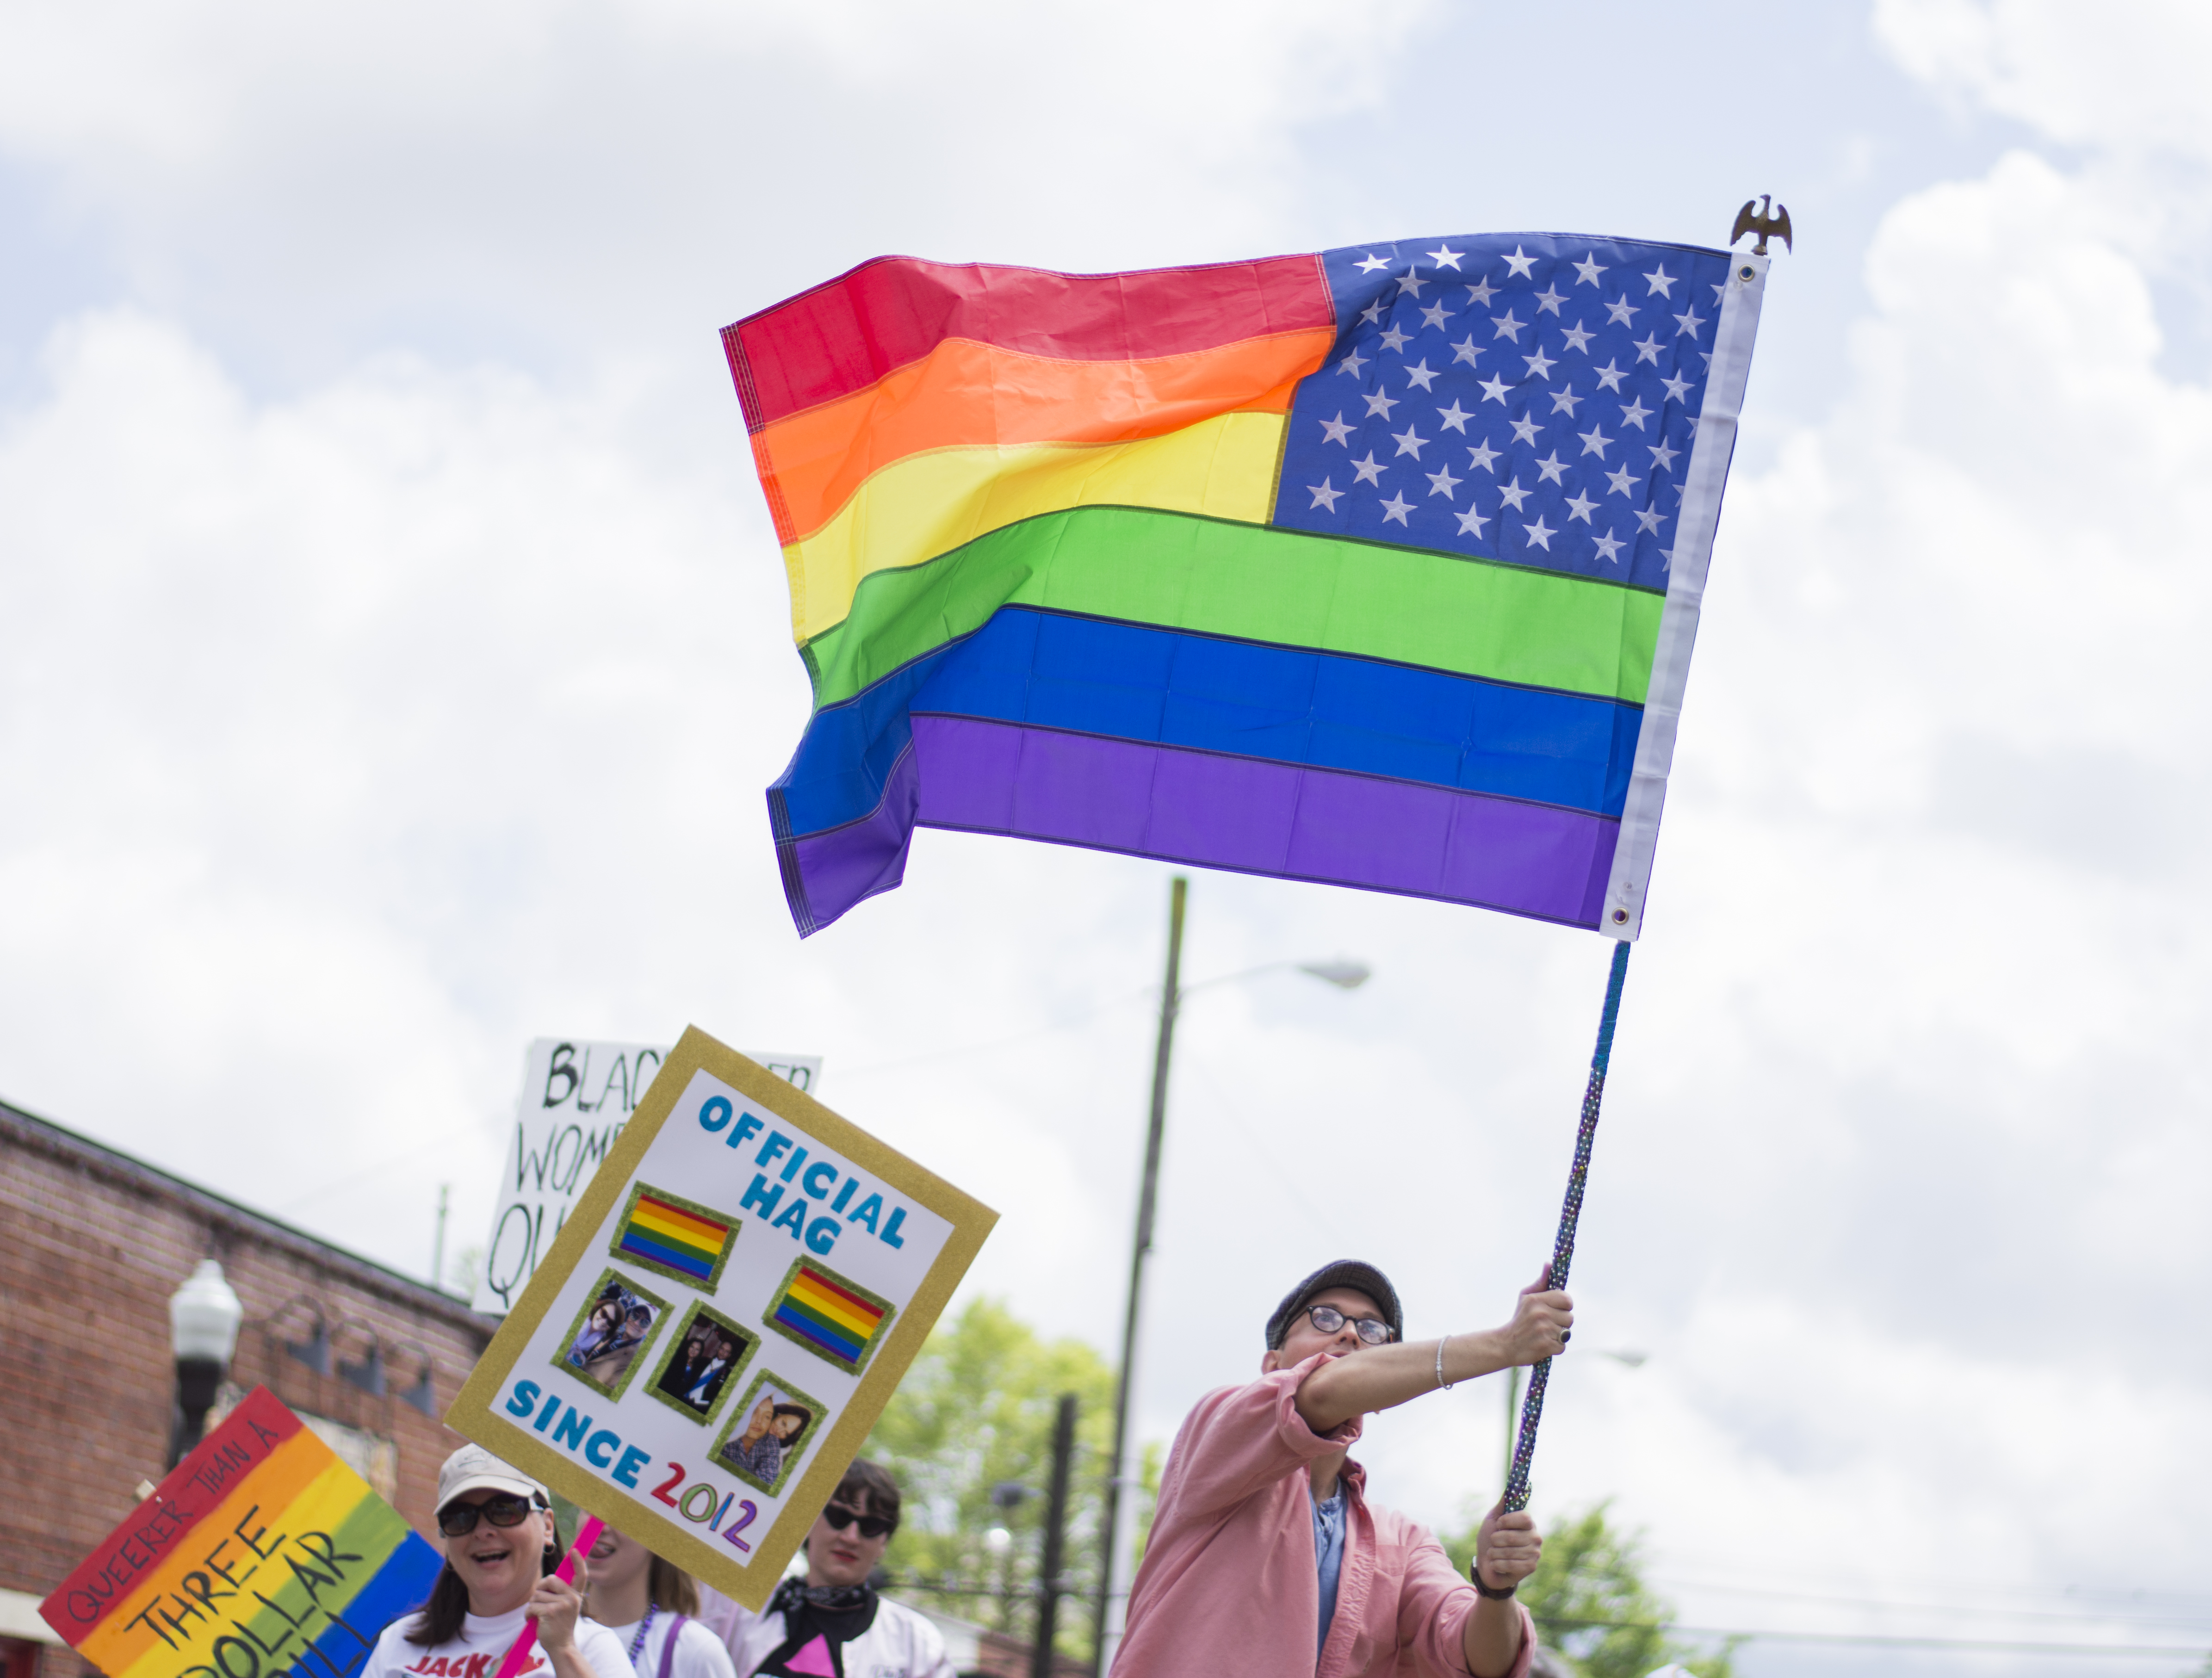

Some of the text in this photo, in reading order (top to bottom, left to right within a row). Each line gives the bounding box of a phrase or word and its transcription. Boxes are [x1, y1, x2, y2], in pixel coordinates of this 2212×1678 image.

[542, 1042, 671, 1112] BLAC
[698, 1095, 907, 1250] OFFICIAL
[739, 1173, 842, 1256] HAG
[68, 1420, 279, 1623] QUEERER THAN A
[505, 1379, 757, 1553] SINCE 2012
[123, 1505, 286, 1651] THREE
[262, 1610, 397, 1678] ILL
